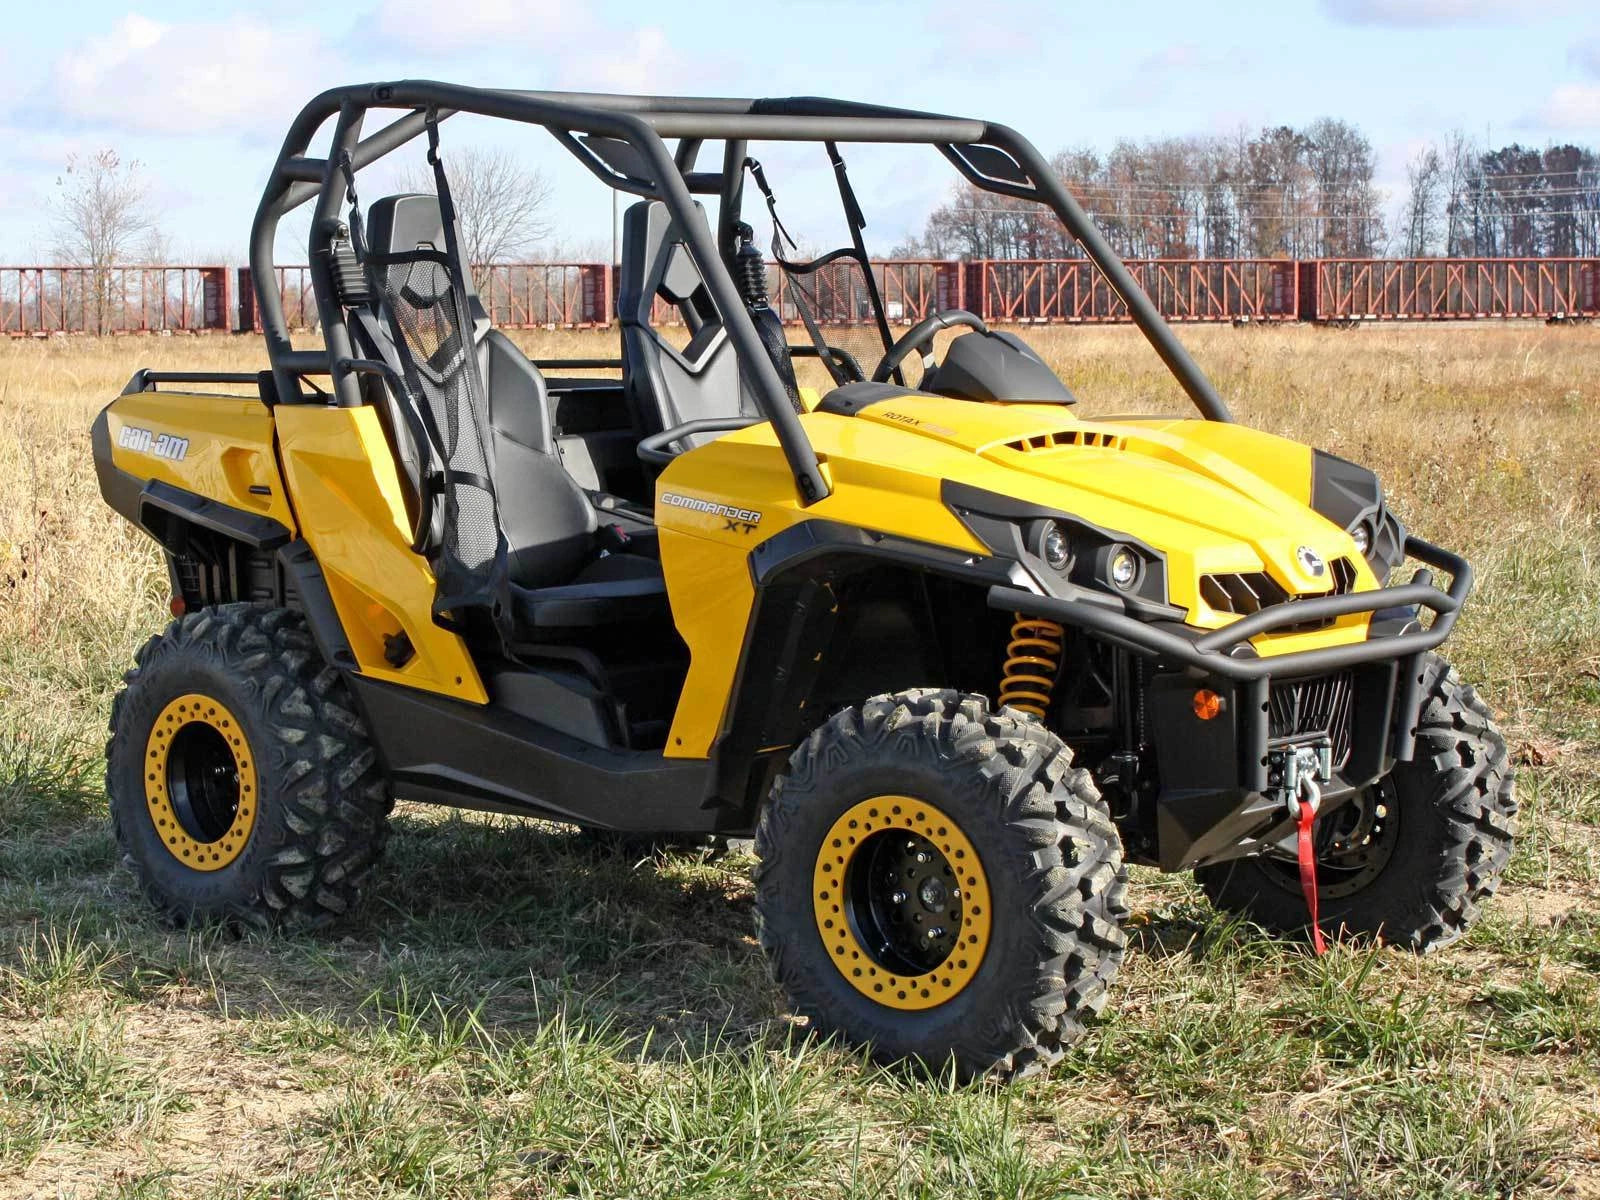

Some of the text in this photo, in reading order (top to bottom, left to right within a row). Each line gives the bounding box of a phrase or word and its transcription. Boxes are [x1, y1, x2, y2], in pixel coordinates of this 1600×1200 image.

[882, 411, 921, 427] ROTAX
[660, 492, 762, 523] COMMANDER
[722, 519, 758, 535] XT
